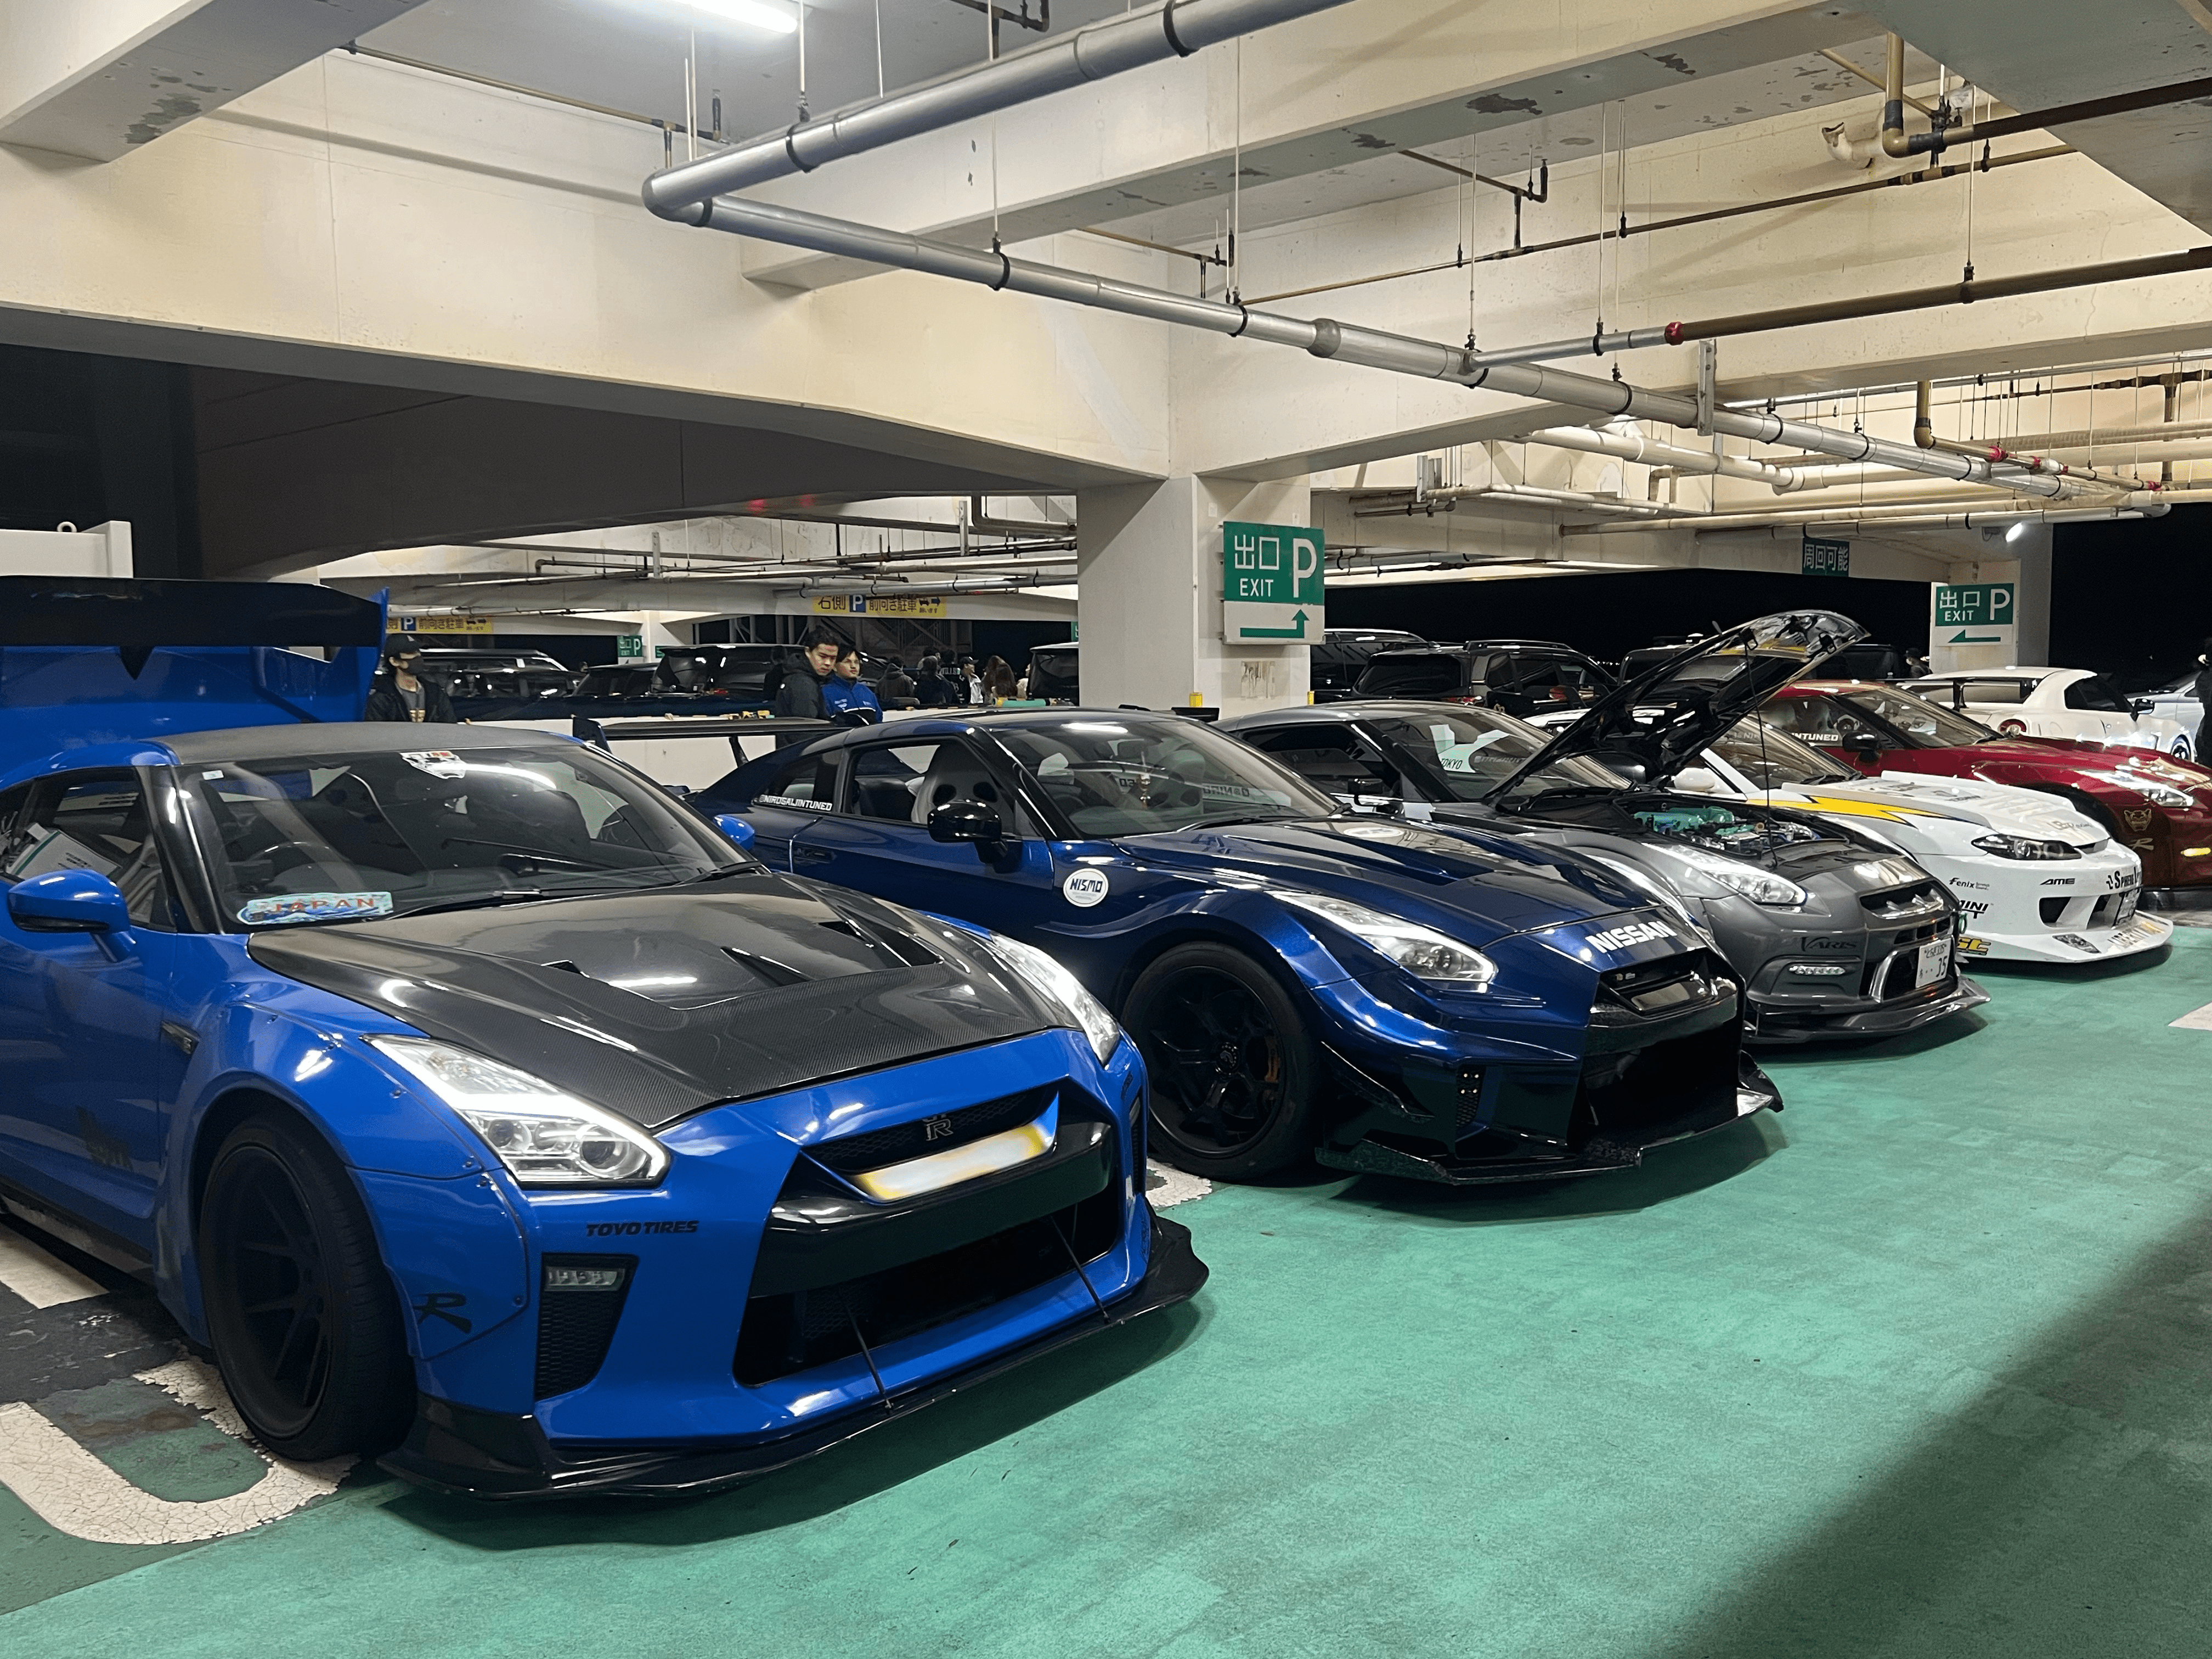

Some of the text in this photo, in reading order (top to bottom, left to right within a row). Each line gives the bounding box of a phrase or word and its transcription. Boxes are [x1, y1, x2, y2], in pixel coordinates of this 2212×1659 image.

[1234, 534, 1280, 571] 出口
[1803, 544, 1848, 571] 周回可能
[1293, 538, 1317, 598] P
[1239, 578, 1274, 597] EXIT
[852, 594, 864, 611] P
[1939, 591, 1980, 609] 出口
[1989, 588, 2010, 620] P
[403, 617, 414, 630] P
[1944, 610, 1974, 622] EXIT
[633, 638, 641, 656] P
[1070, 878, 1103, 894] NISMO
[1949, 877, 1975, 889] Fenix
[2040, 878, 2076, 886] AME
[272, 896, 376, 913] JAPAN
[1584, 921, 1678, 953] NISSAN
[586, 1220, 700, 1237] TOYO TIRES
